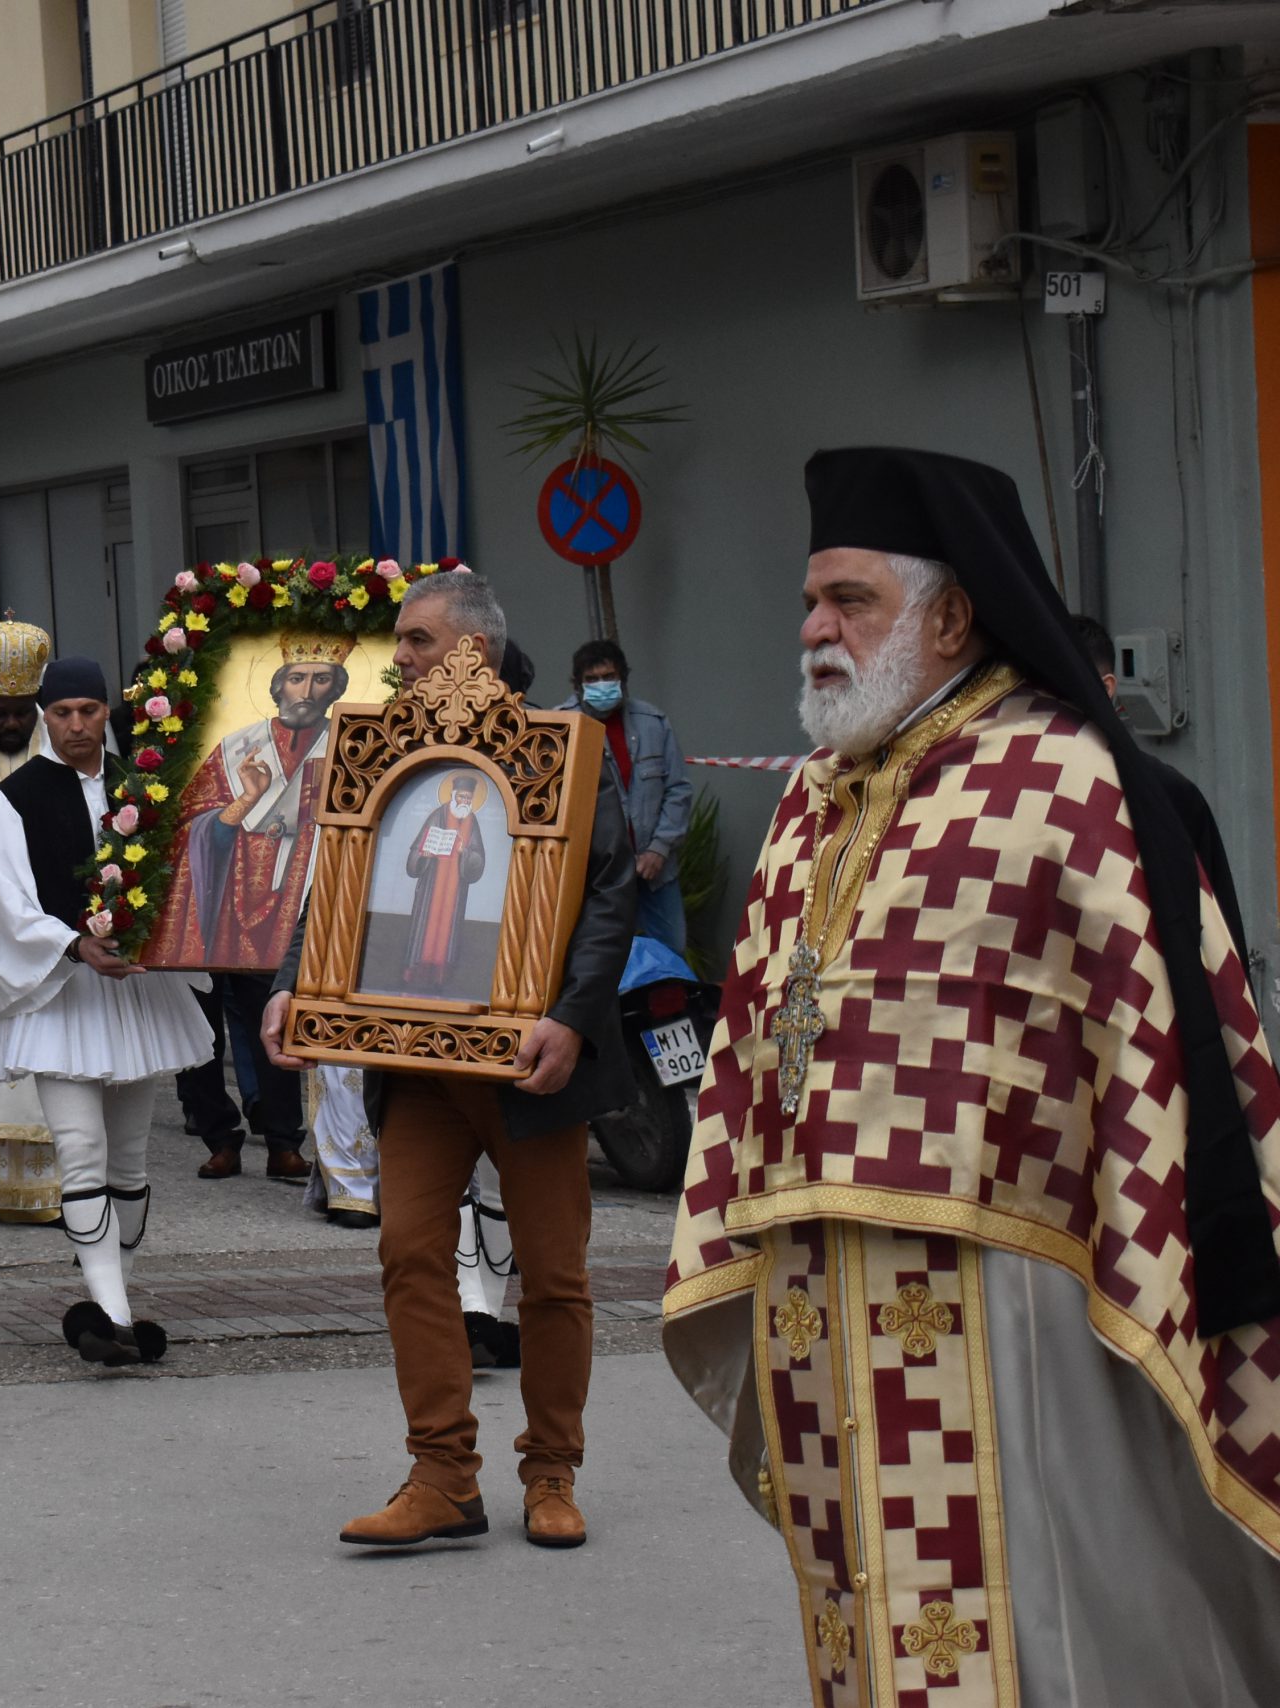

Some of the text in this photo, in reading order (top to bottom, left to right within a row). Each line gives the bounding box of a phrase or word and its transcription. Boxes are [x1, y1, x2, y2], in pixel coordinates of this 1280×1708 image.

[1047, 274, 1082, 297] 501
[1094, 300, 1102, 313] 5
[153, 329, 302, 398] ΟΙΚΟΣ ΤΕΛΕΤΩΝ
[656, 1024, 692, 1052] MIY
[668, 1051, 705, 1076] 902
